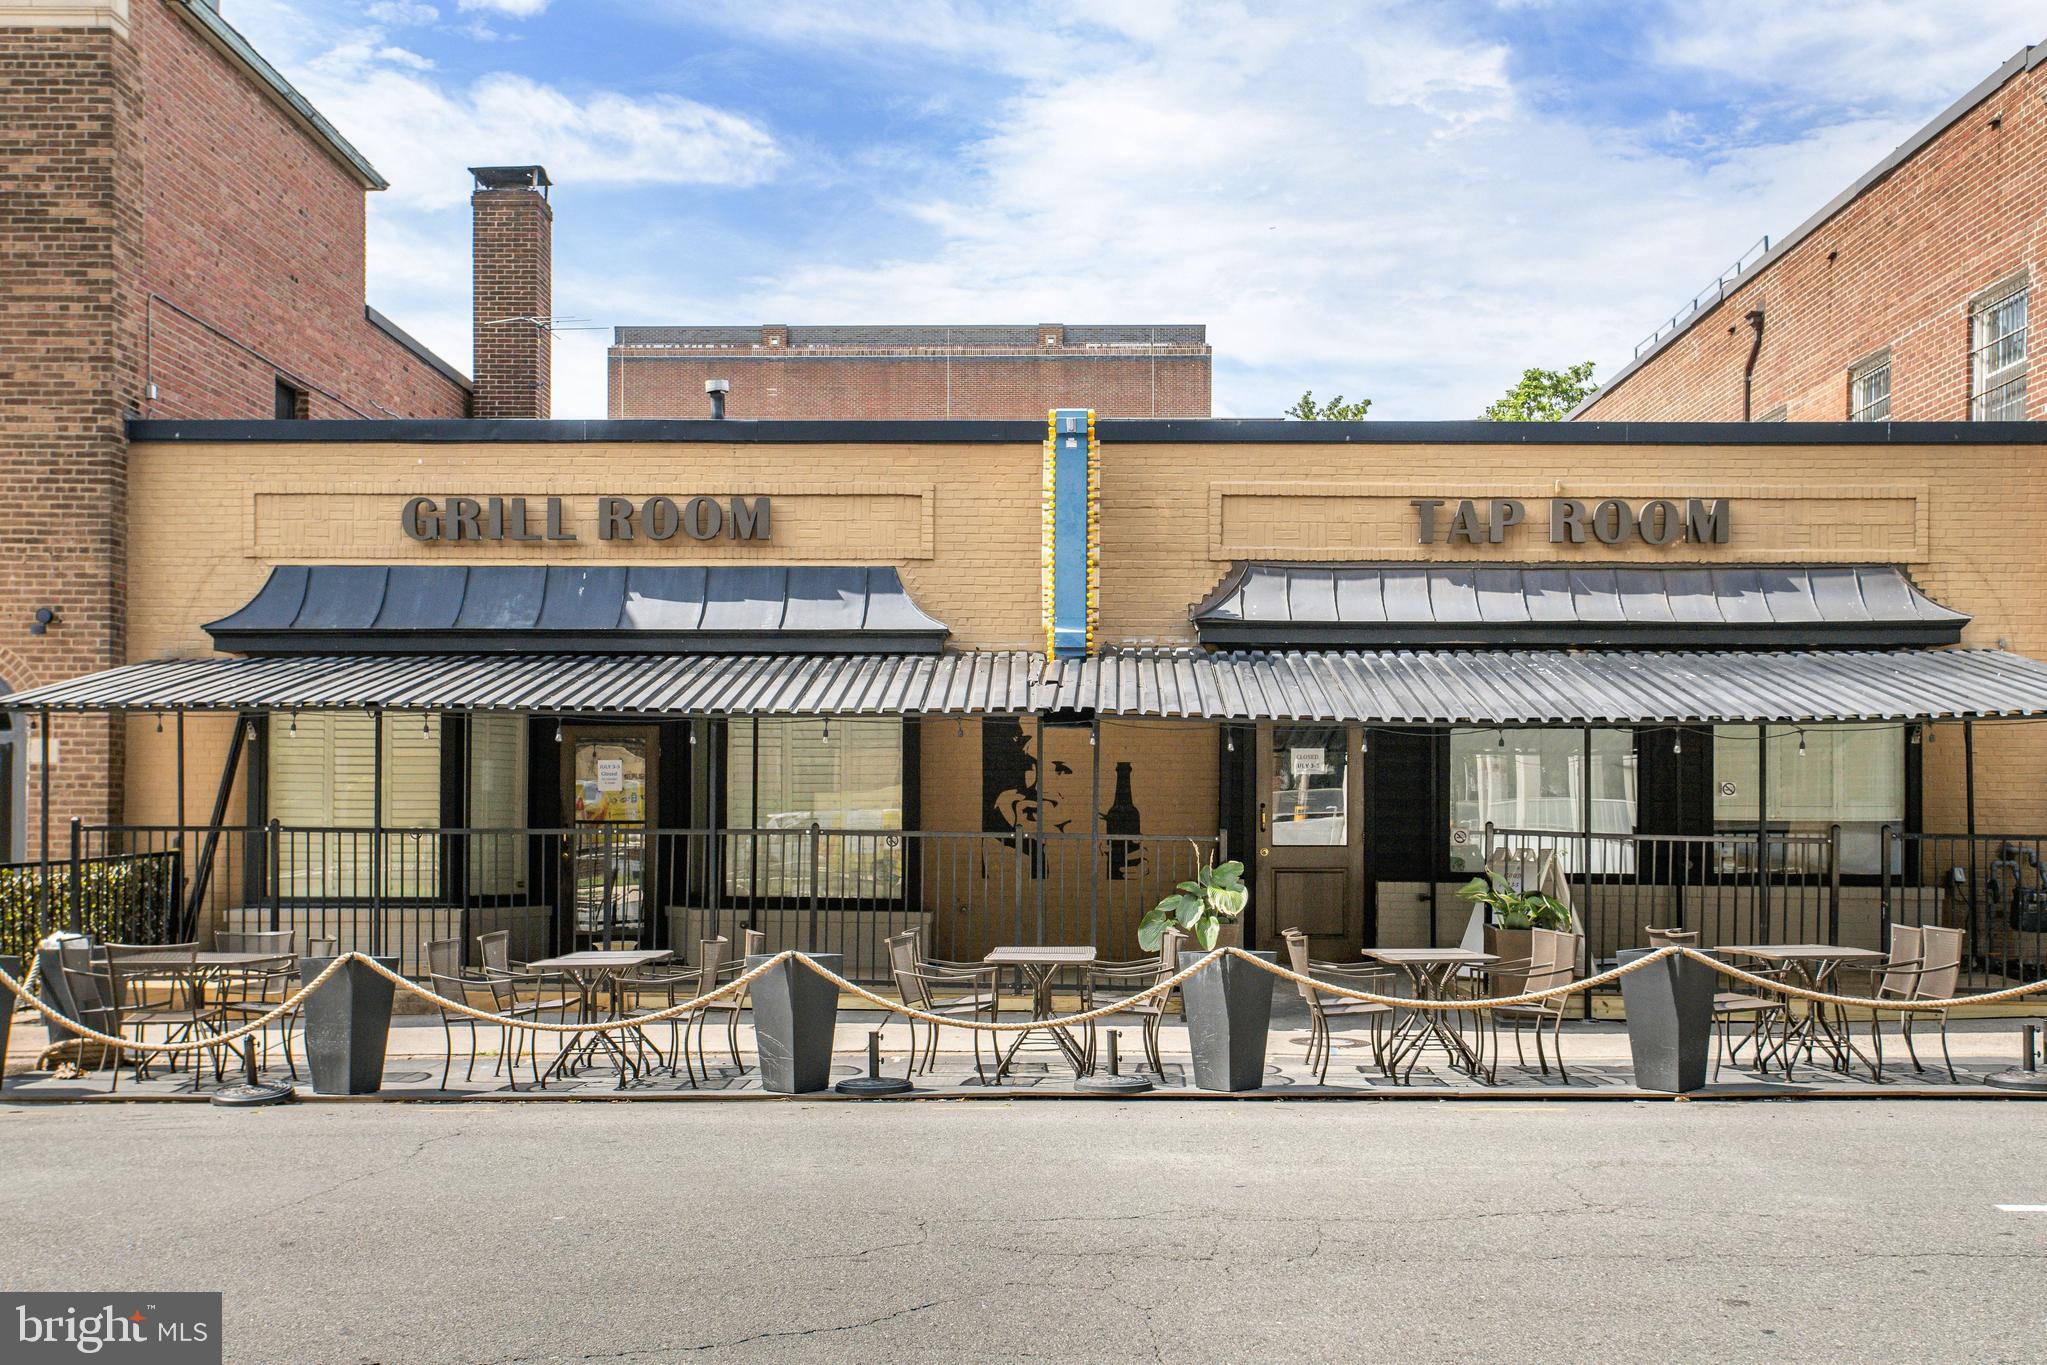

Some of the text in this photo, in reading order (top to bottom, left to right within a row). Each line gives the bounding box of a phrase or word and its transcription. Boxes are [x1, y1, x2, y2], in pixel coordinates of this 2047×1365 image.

[402, 496, 771, 541] GRILL ROOM
[1410, 499, 1730, 545] TAP ROOM
